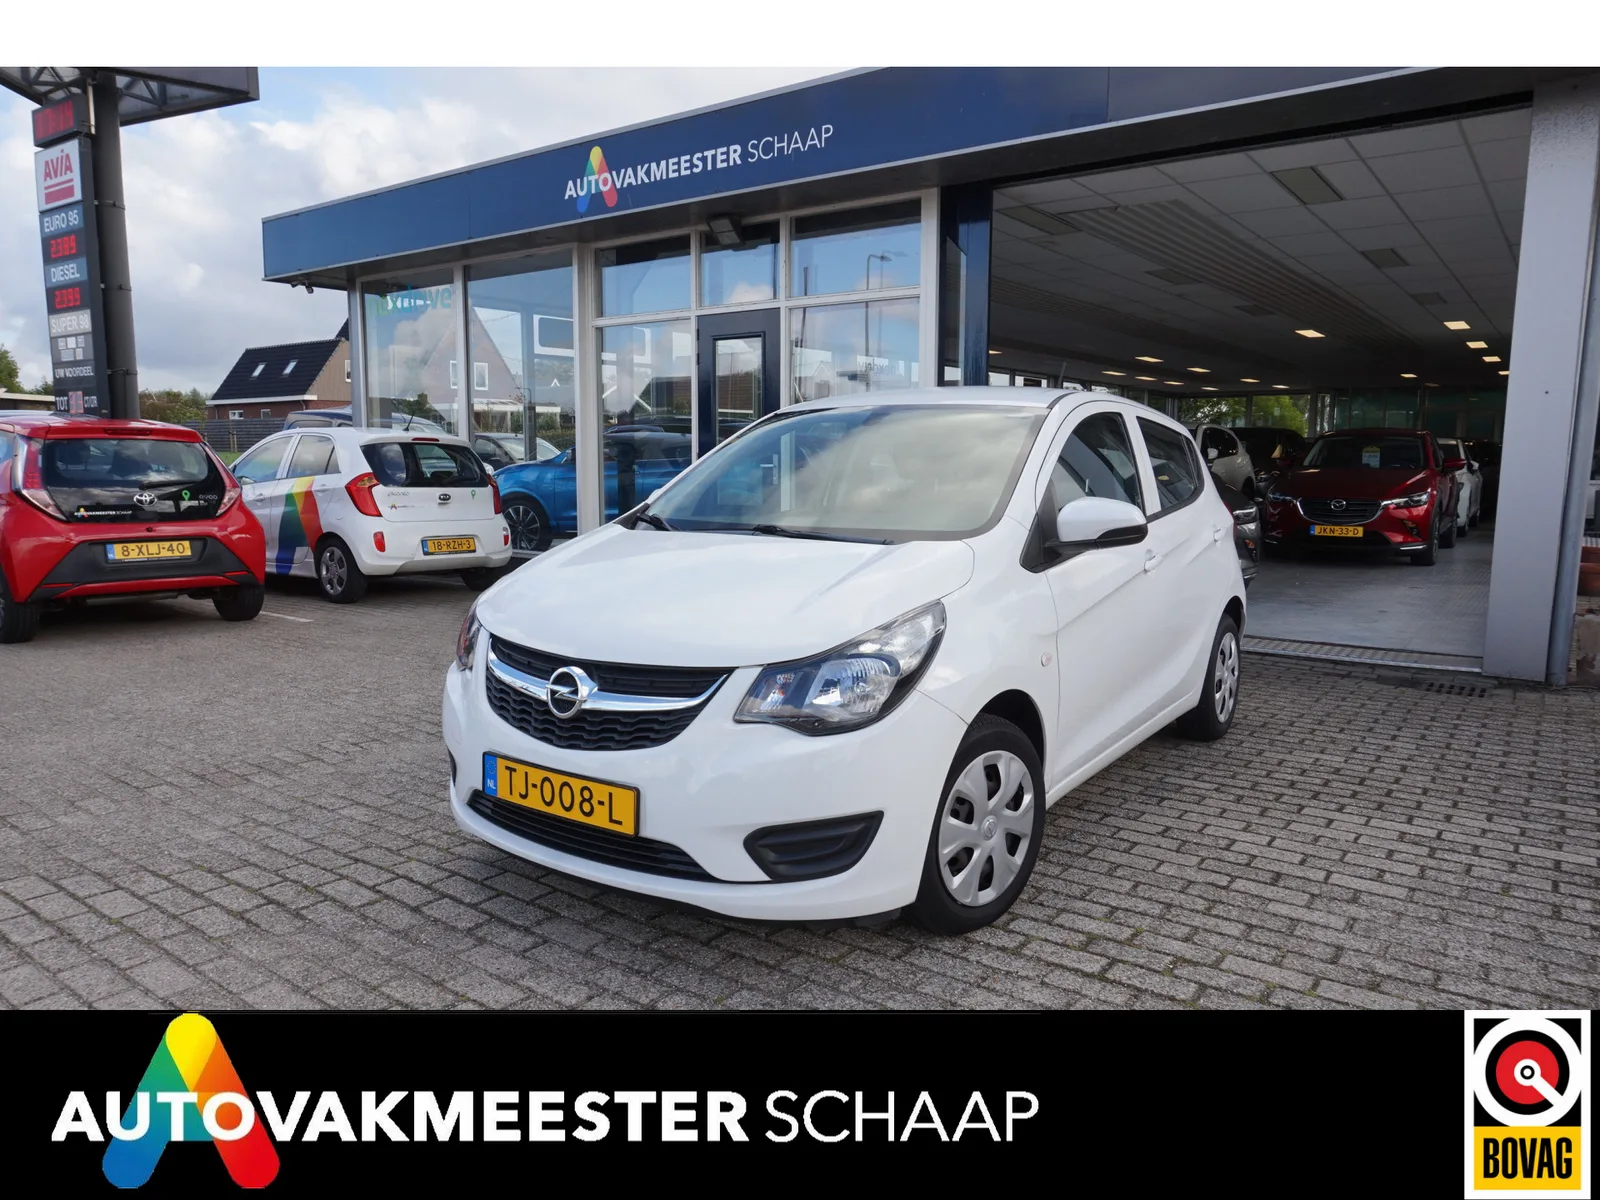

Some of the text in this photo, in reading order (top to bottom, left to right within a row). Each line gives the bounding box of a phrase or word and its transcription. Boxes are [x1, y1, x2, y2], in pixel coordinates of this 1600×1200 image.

[44, 149, 73, 181] AVIA
[564, 124, 834, 200] AUTOVAKMEESTER SCHAAP
[44, 209, 79, 232] EURO 95
[51, 264, 80, 282] DIESEL
[55, 397, 68, 410] TOT
[1317, 527, 1359, 535] JKN-33-D
[121, 542, 186, 557] 8-XLJ-40
[432, 540, 471, 550] 18-RZH-3
[487, 778, 496, 790] NL
[504, 765, 623, 826] TJ-008-L
